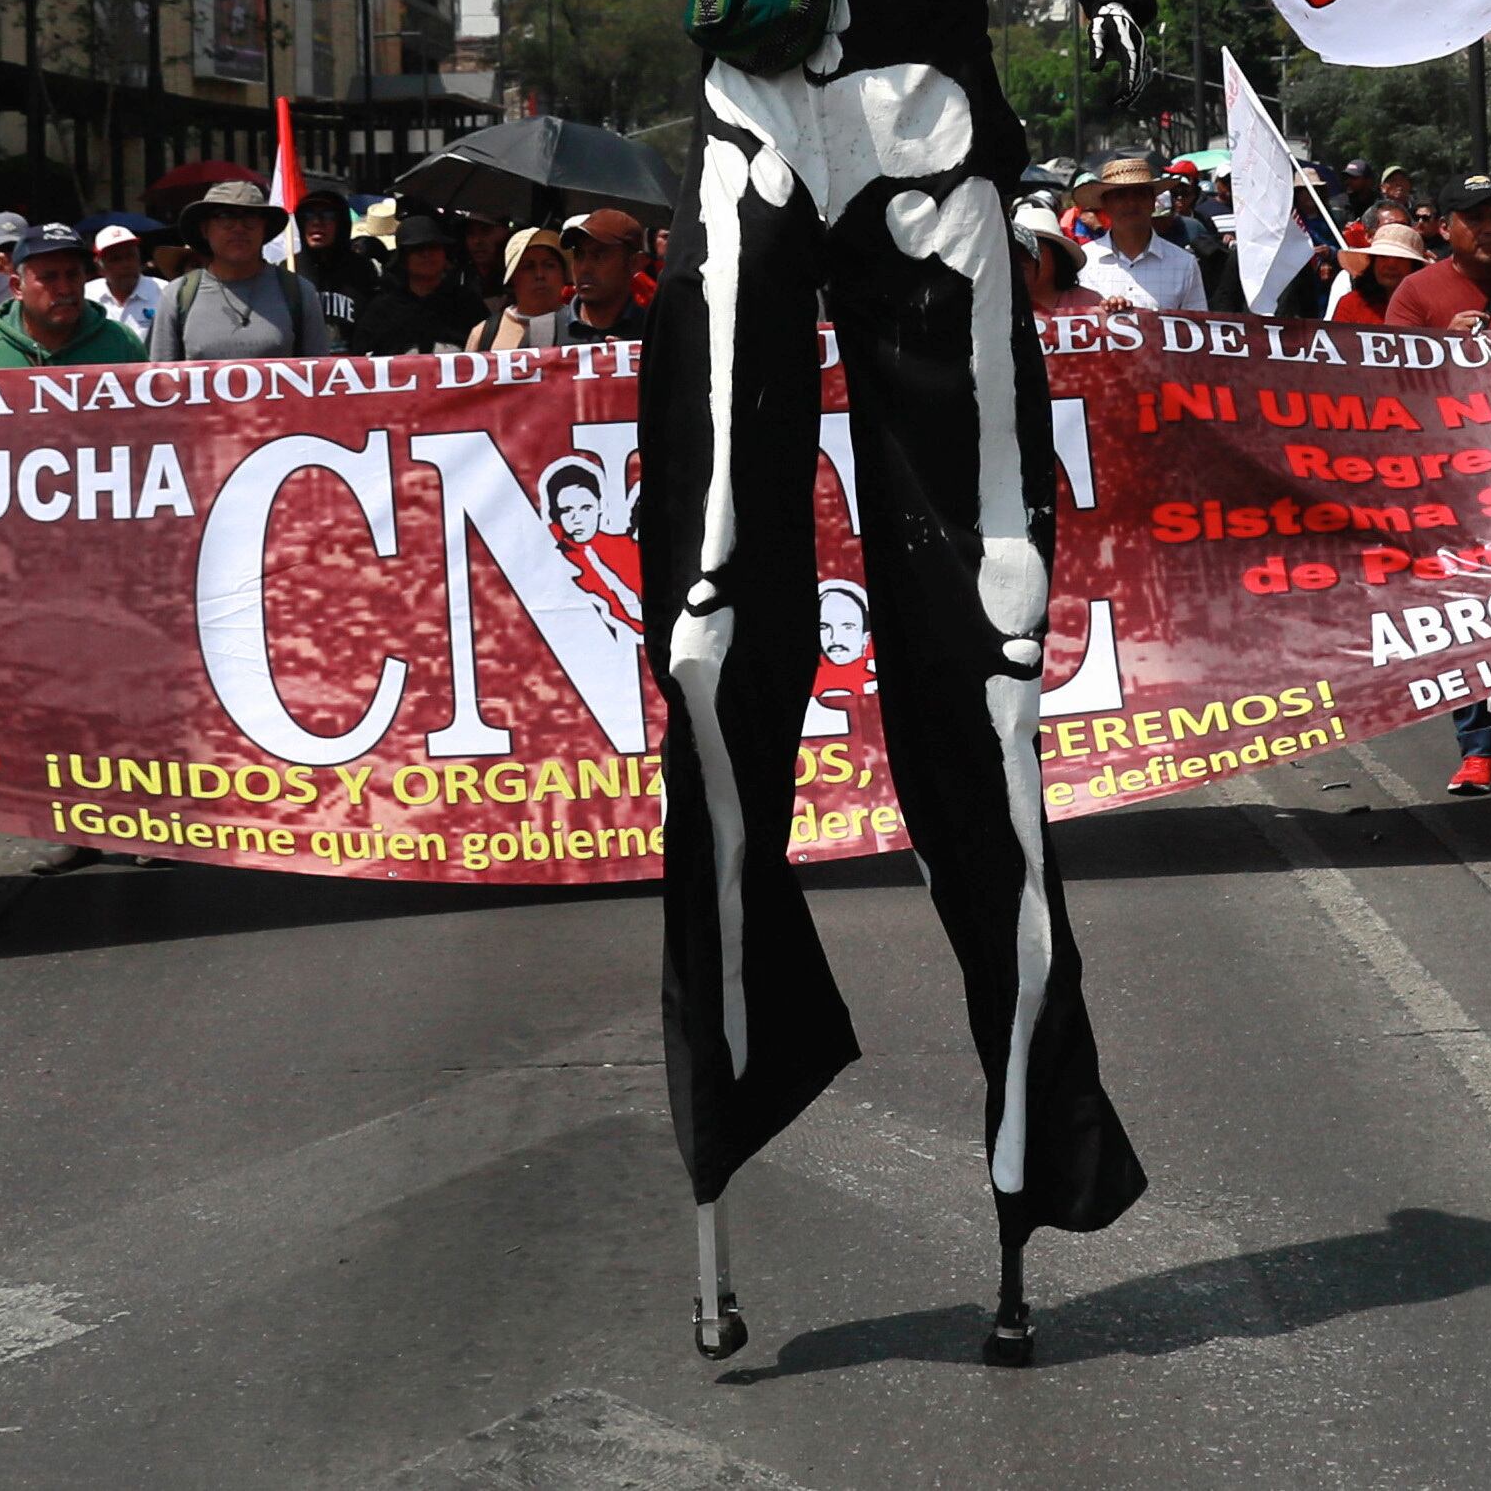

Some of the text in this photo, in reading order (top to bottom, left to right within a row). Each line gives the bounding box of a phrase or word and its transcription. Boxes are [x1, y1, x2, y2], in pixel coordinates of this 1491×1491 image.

[30, 353, 418, 415] NACIONAL
[435, 345, 545, 391] DE
[1161, 314, 1249, 359] DE
[1259, 323, 1349, 366] LA
[1258, 392, 1421, 433] UMA
[1151, 498, 1458, 543] Sistema
[1241, 557, 1338, 594] de
[1408, 666, 1472, 711] DE
[45, 752, 317, 806] ¡UNIDOS
[342, 766, 387, 806] Y
[391, 741, 874, 808] ORGANIZOS,
[51, 800, 297, 858] ¡Gobierne
[309, 823, 447, 868] quien
[1086, 716, 1347, 799] defienden!
